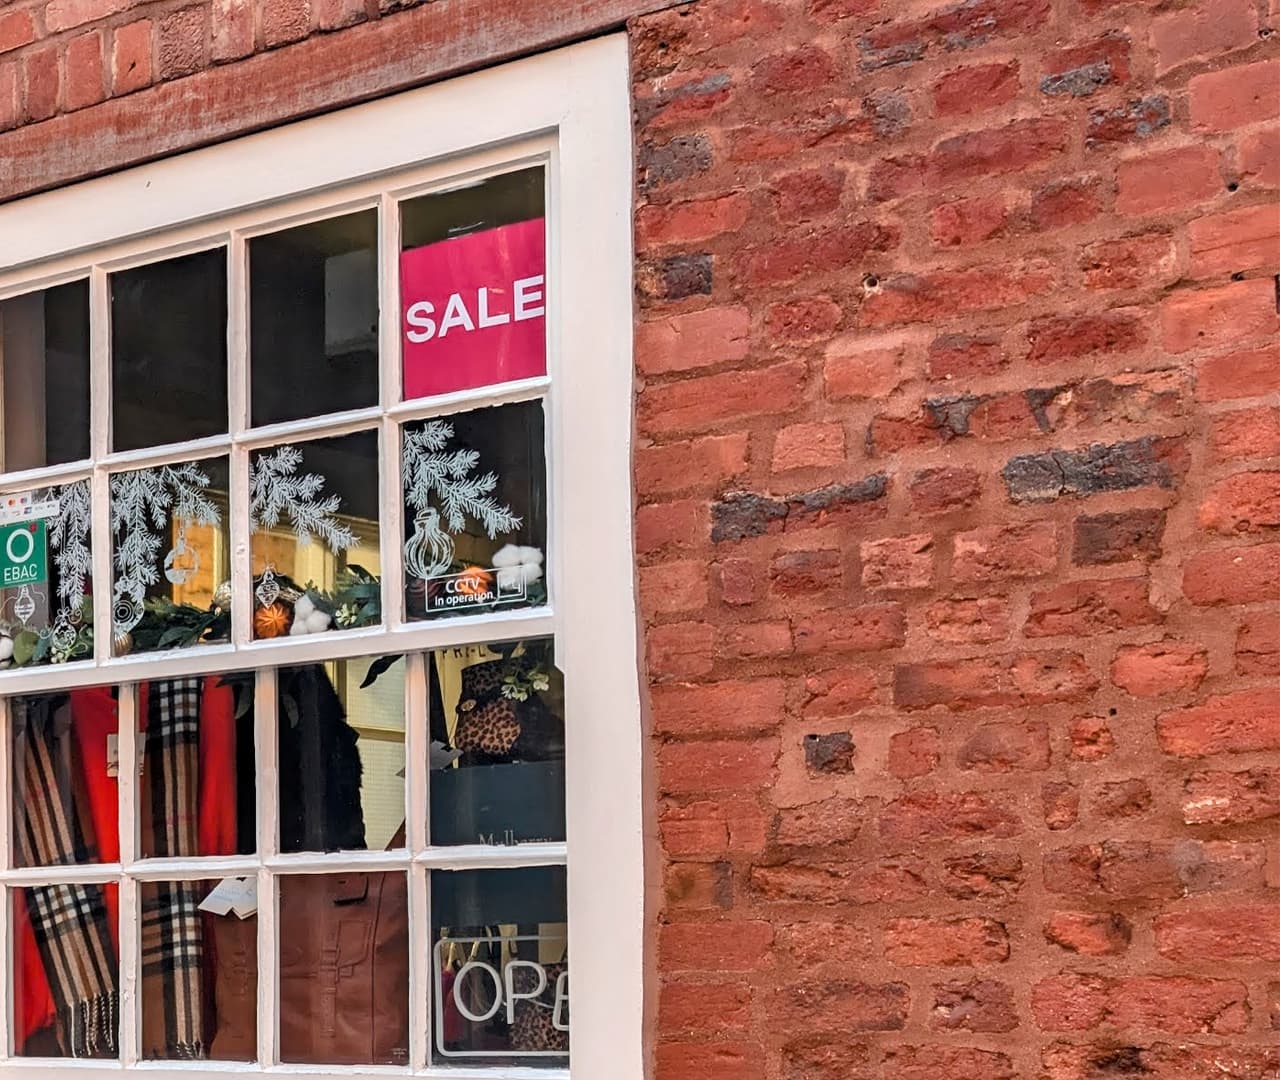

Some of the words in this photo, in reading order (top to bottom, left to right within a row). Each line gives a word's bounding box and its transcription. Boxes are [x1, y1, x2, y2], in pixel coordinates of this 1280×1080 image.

[406, 274, 545, 343] SALE
[4, 563, 38, 581] EBAC
[445, 576, 481, 594] CCTV
